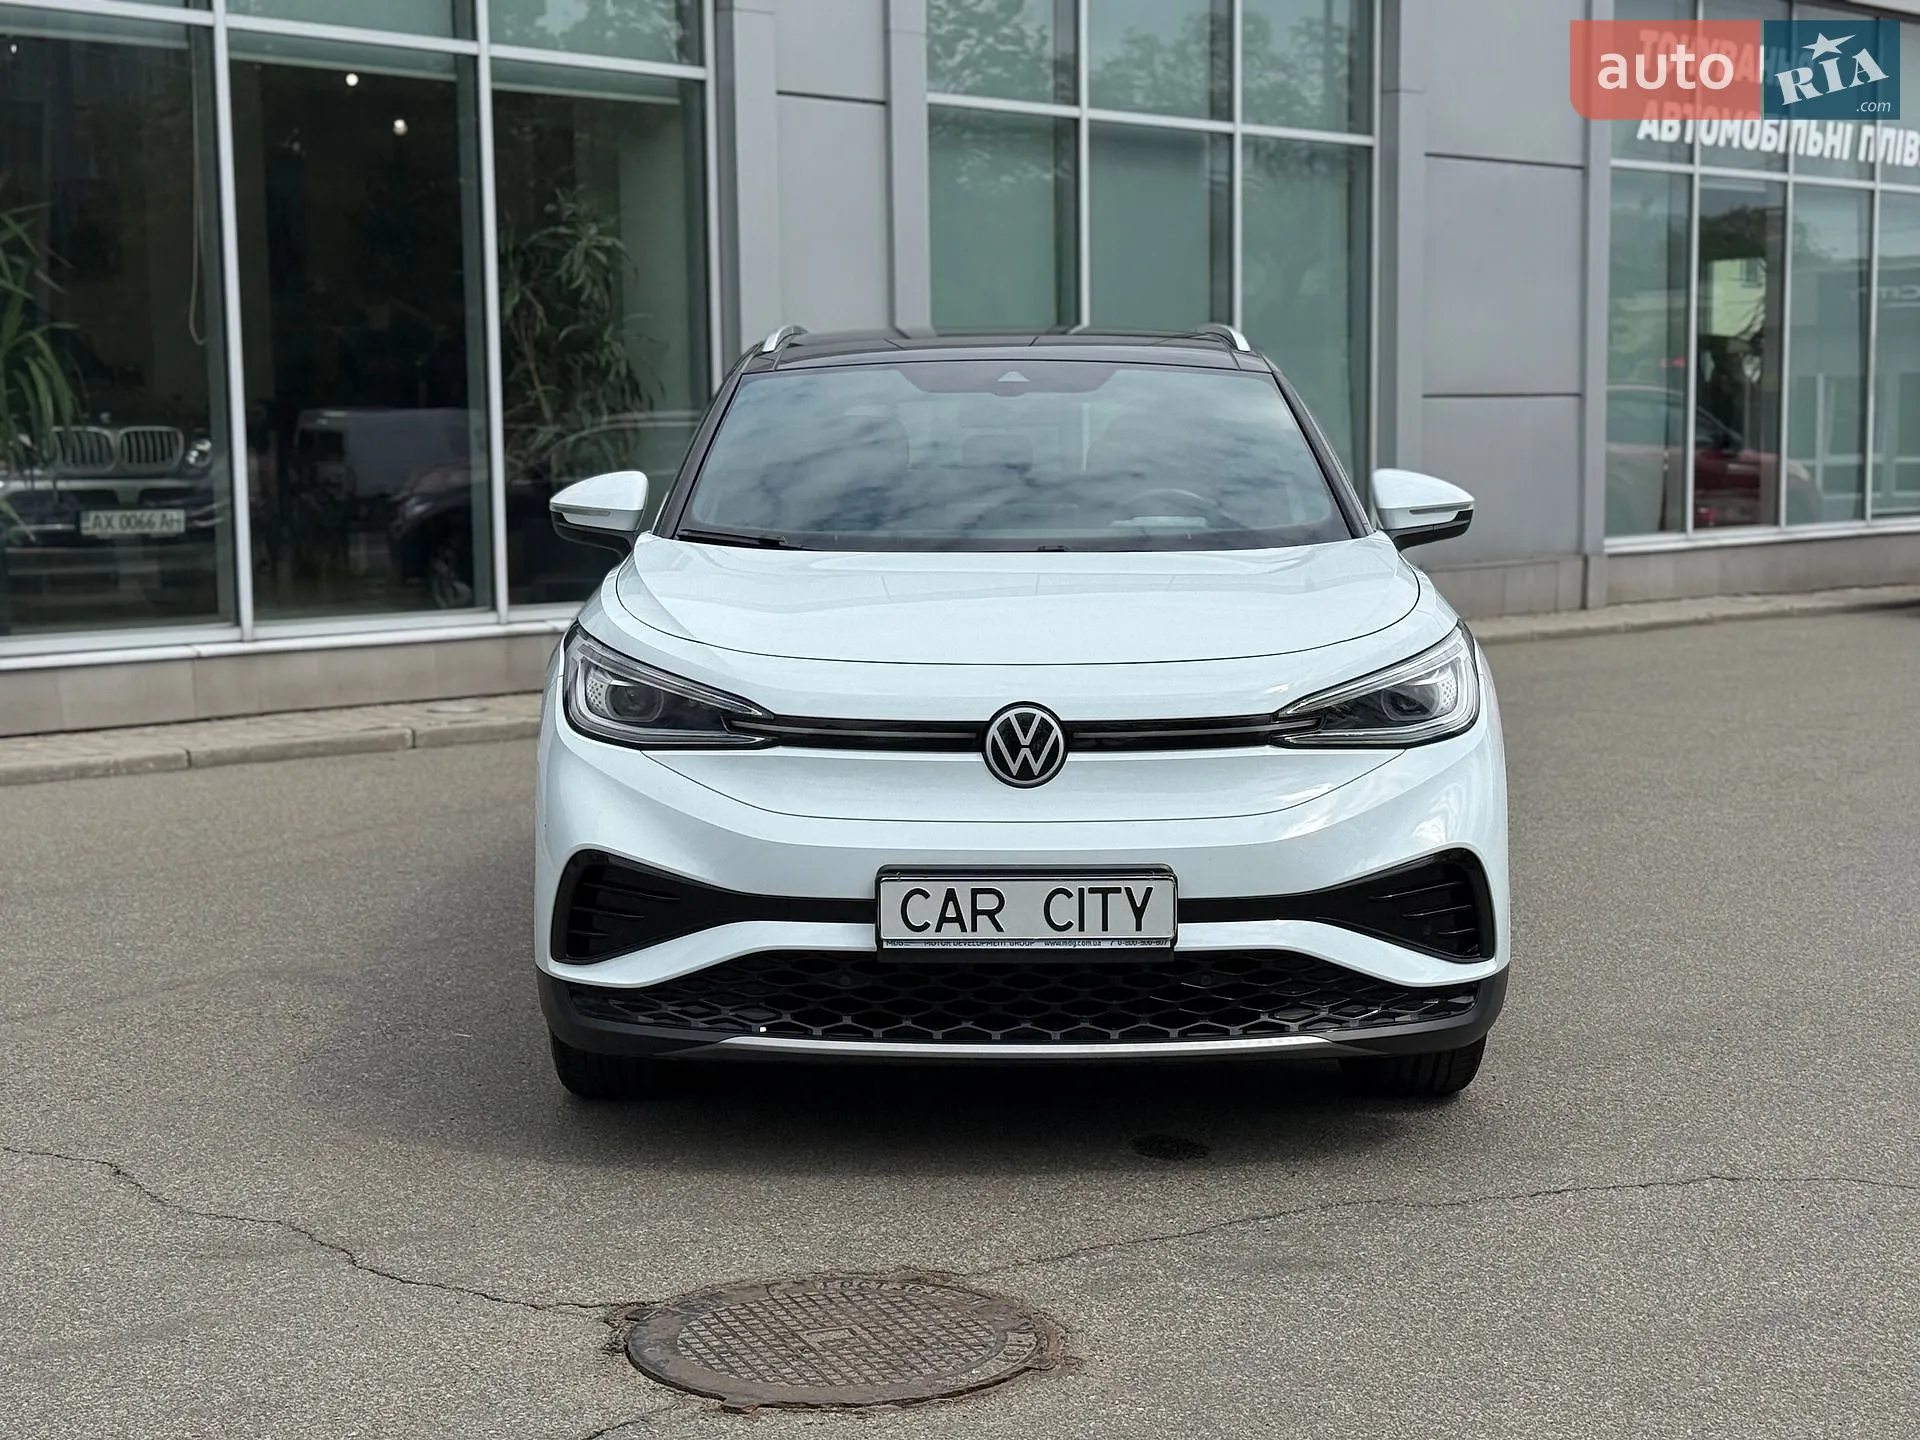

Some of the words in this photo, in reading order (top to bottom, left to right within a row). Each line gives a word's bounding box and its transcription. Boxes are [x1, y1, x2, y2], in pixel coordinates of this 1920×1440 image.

[1637, 100, 1852, 161] АВТОМОБІЛЬНІ
[900, 886, 1005, 933] CAR
[1043, 886, 1153, 932] CITY
